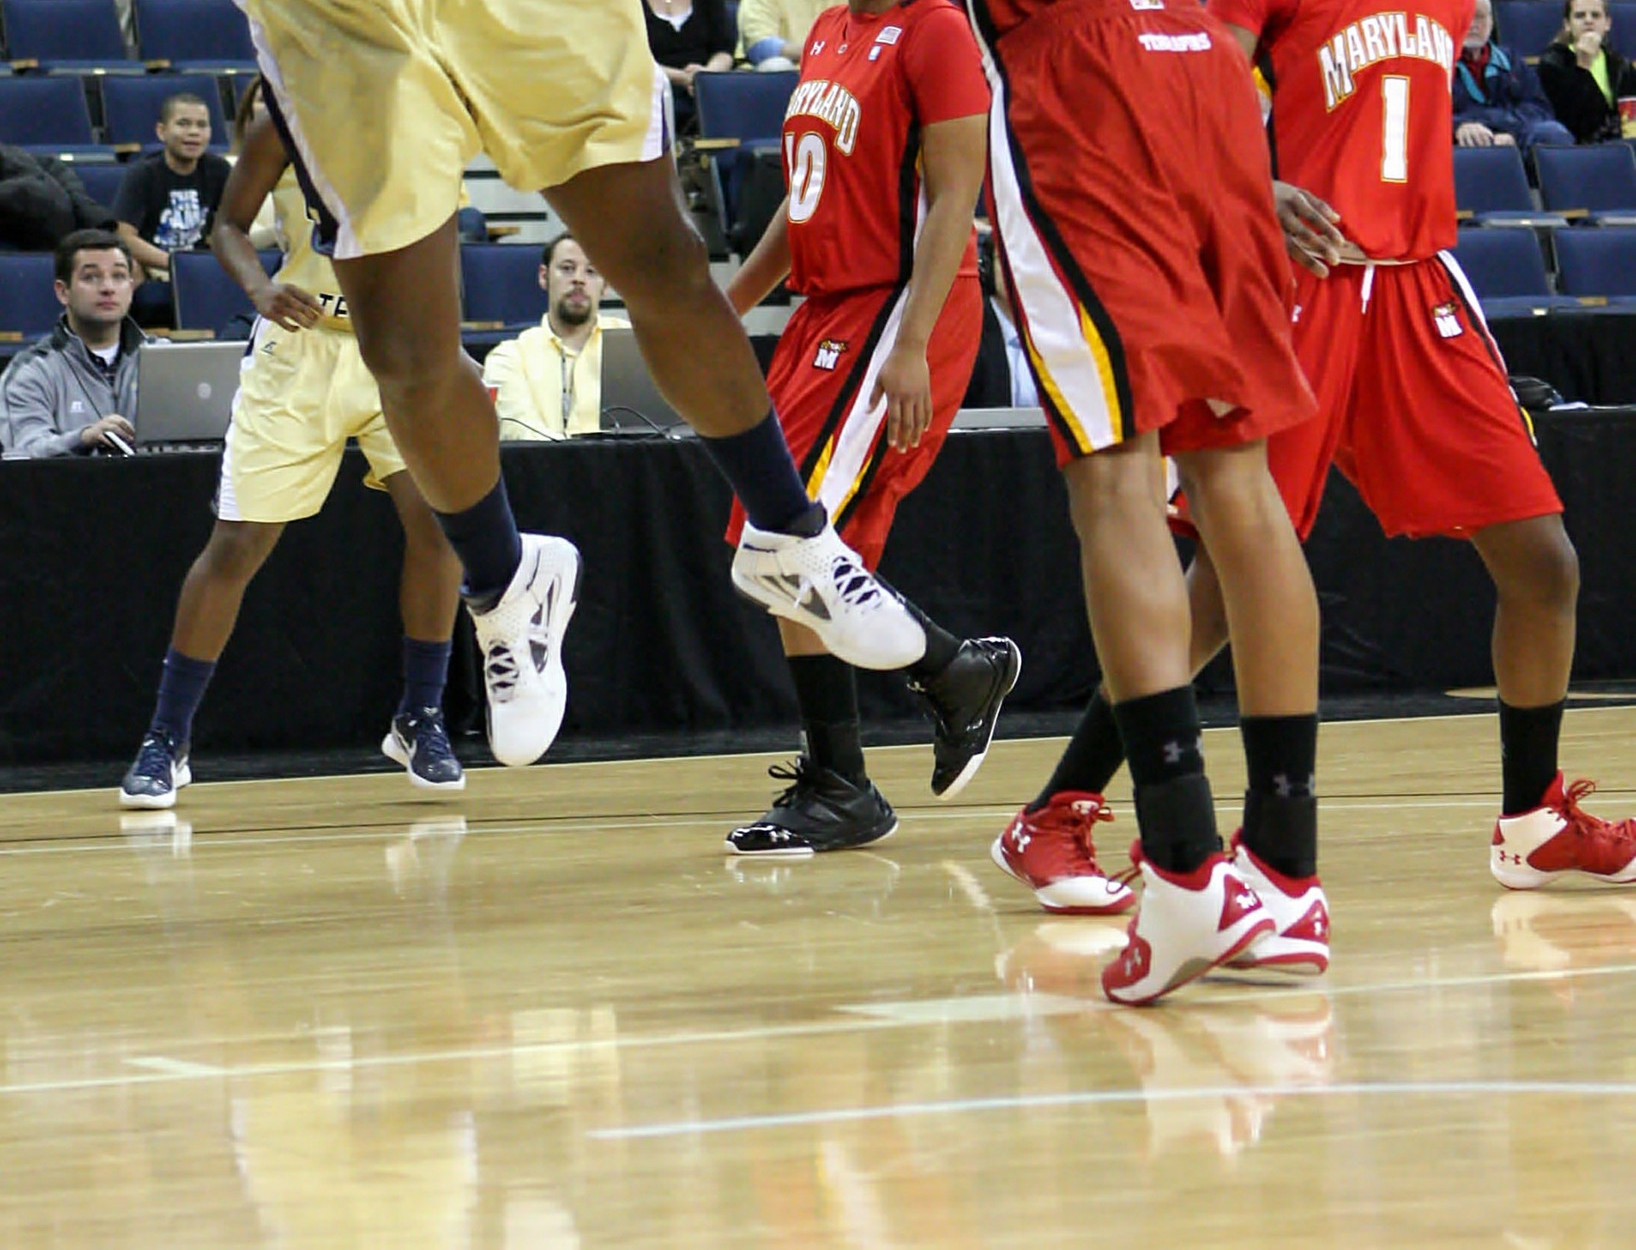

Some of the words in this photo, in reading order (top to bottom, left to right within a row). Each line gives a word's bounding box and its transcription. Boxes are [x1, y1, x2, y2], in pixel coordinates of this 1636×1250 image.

[784, 79, 861, 157] ARYLAND
[1381, 74, 1410, 183] 1
[318, 292, 348, 318] TE
[813, 347, 840, 370] M
